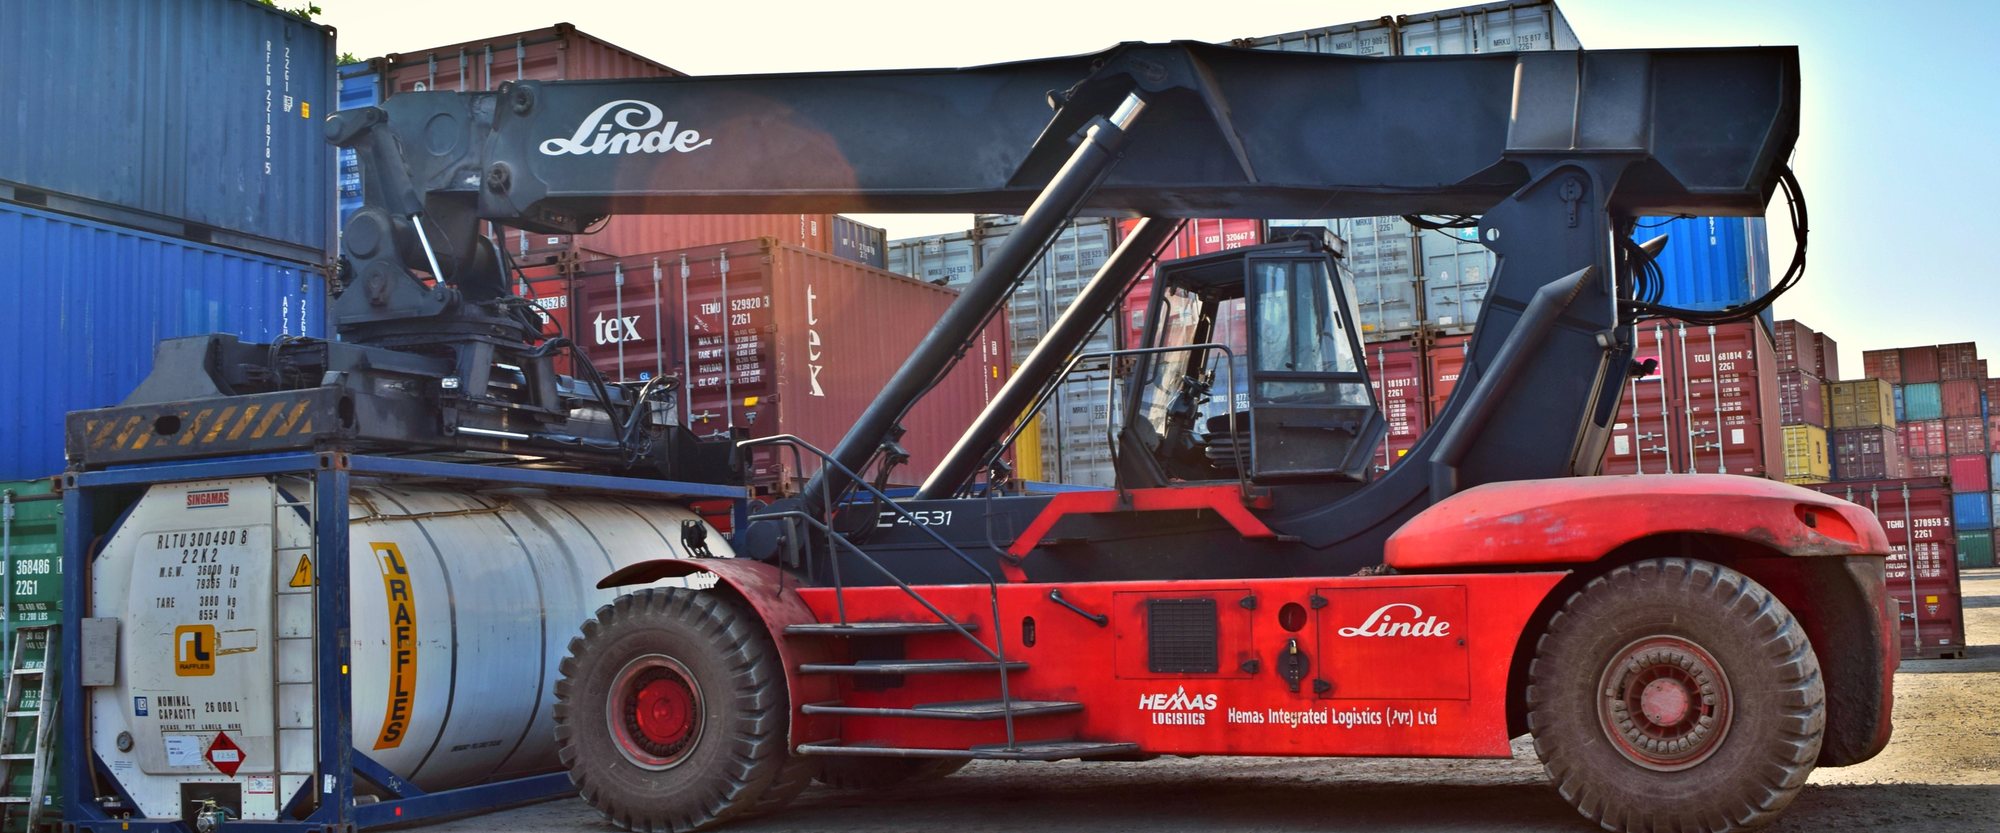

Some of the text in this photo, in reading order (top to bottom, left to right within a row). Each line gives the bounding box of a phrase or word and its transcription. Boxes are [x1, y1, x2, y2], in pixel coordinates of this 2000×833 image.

[1336, 41, 1352, 49] MRKU
[1493, 38, 1511, 46] MRKU
[539, 99, 713, 156] Linde
[265, 162, 271, 174] 5
[1356, 218, 1372, 226] MRKU
[1226, 232, 1248, 242] 320667
[1250, 230, 1255, 240] 9
[701, 296, 769, 315] TEMU 529920 3
[732, 313, 751, 325] 22G1
[594, 312, 642, 345] tex
[1694, 350, 1752, 363] TCLU 681814 2
[1719, 362, 1735, 371] 22G1
[640, 373, 650, 381] GL
[1388, 378, 1410, 388] 181917
[1388, 389, 1403, 397] 22G1
[187, 491, 229, 507] SINGAMAS
[1886, 517, 1950, 529] TGHU 370959 5
[241, 529, 248, 545] 8
[1915, 529, 1932, 539] 22G1
[16, 559, 50, 576] 368486
[230, 564, 240, 576] kg
[16, 580, 38, 595] 22G1
[229, 577, 237, 589] lb
[157, 597, 175, 609] TARE
[227, 595, 237, 608] kg
[38, 612, 48, 620] LBS
[227, 608, 235, 620] lb
[1338, 603, 1450, 637] Linde
[383, 579, 412, 742] RAFFLES
[157, 695, 240, 713] NOMINAL 26 000 L
[1138, 688, 1219, 711] HEMAS
[158, 708, 196, 720] CAPACITY
[1152, 712, 1206, 725] LOGISTICS
[1228, 707, 1265, 724] Hemas
[1268, 708, 1328, 729] Integrated
[1332, 707, 1382, 729] Logistics
[1418, 707, 1438, 725] Ltd
